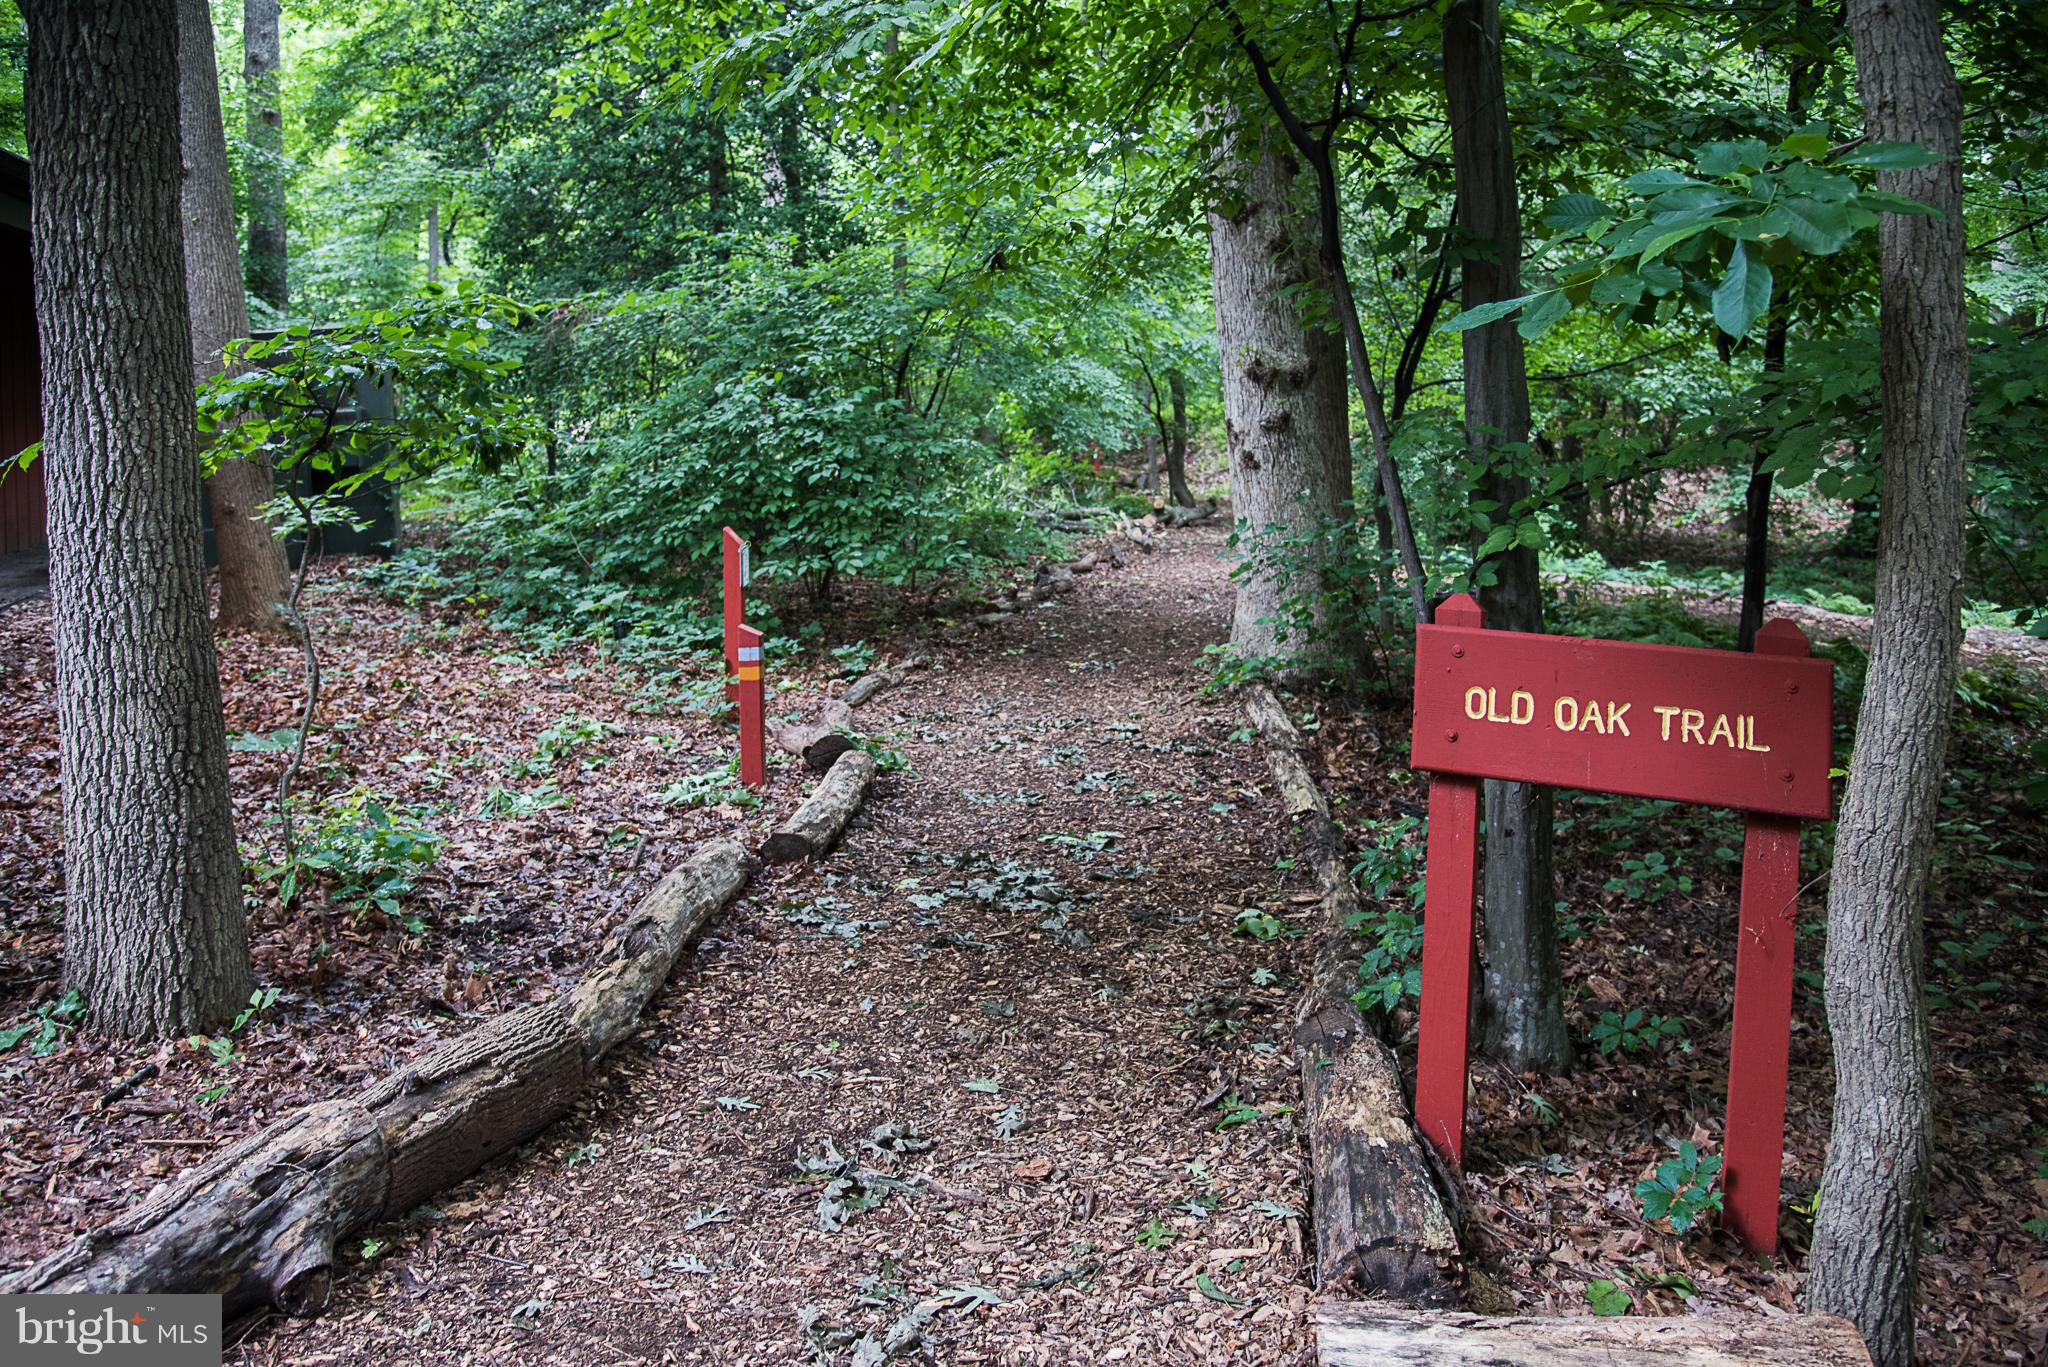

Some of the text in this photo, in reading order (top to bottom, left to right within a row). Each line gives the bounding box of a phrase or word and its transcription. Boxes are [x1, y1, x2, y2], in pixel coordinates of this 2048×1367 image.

[1465, 686, 1772, 752] OLD OAK TRAIL
